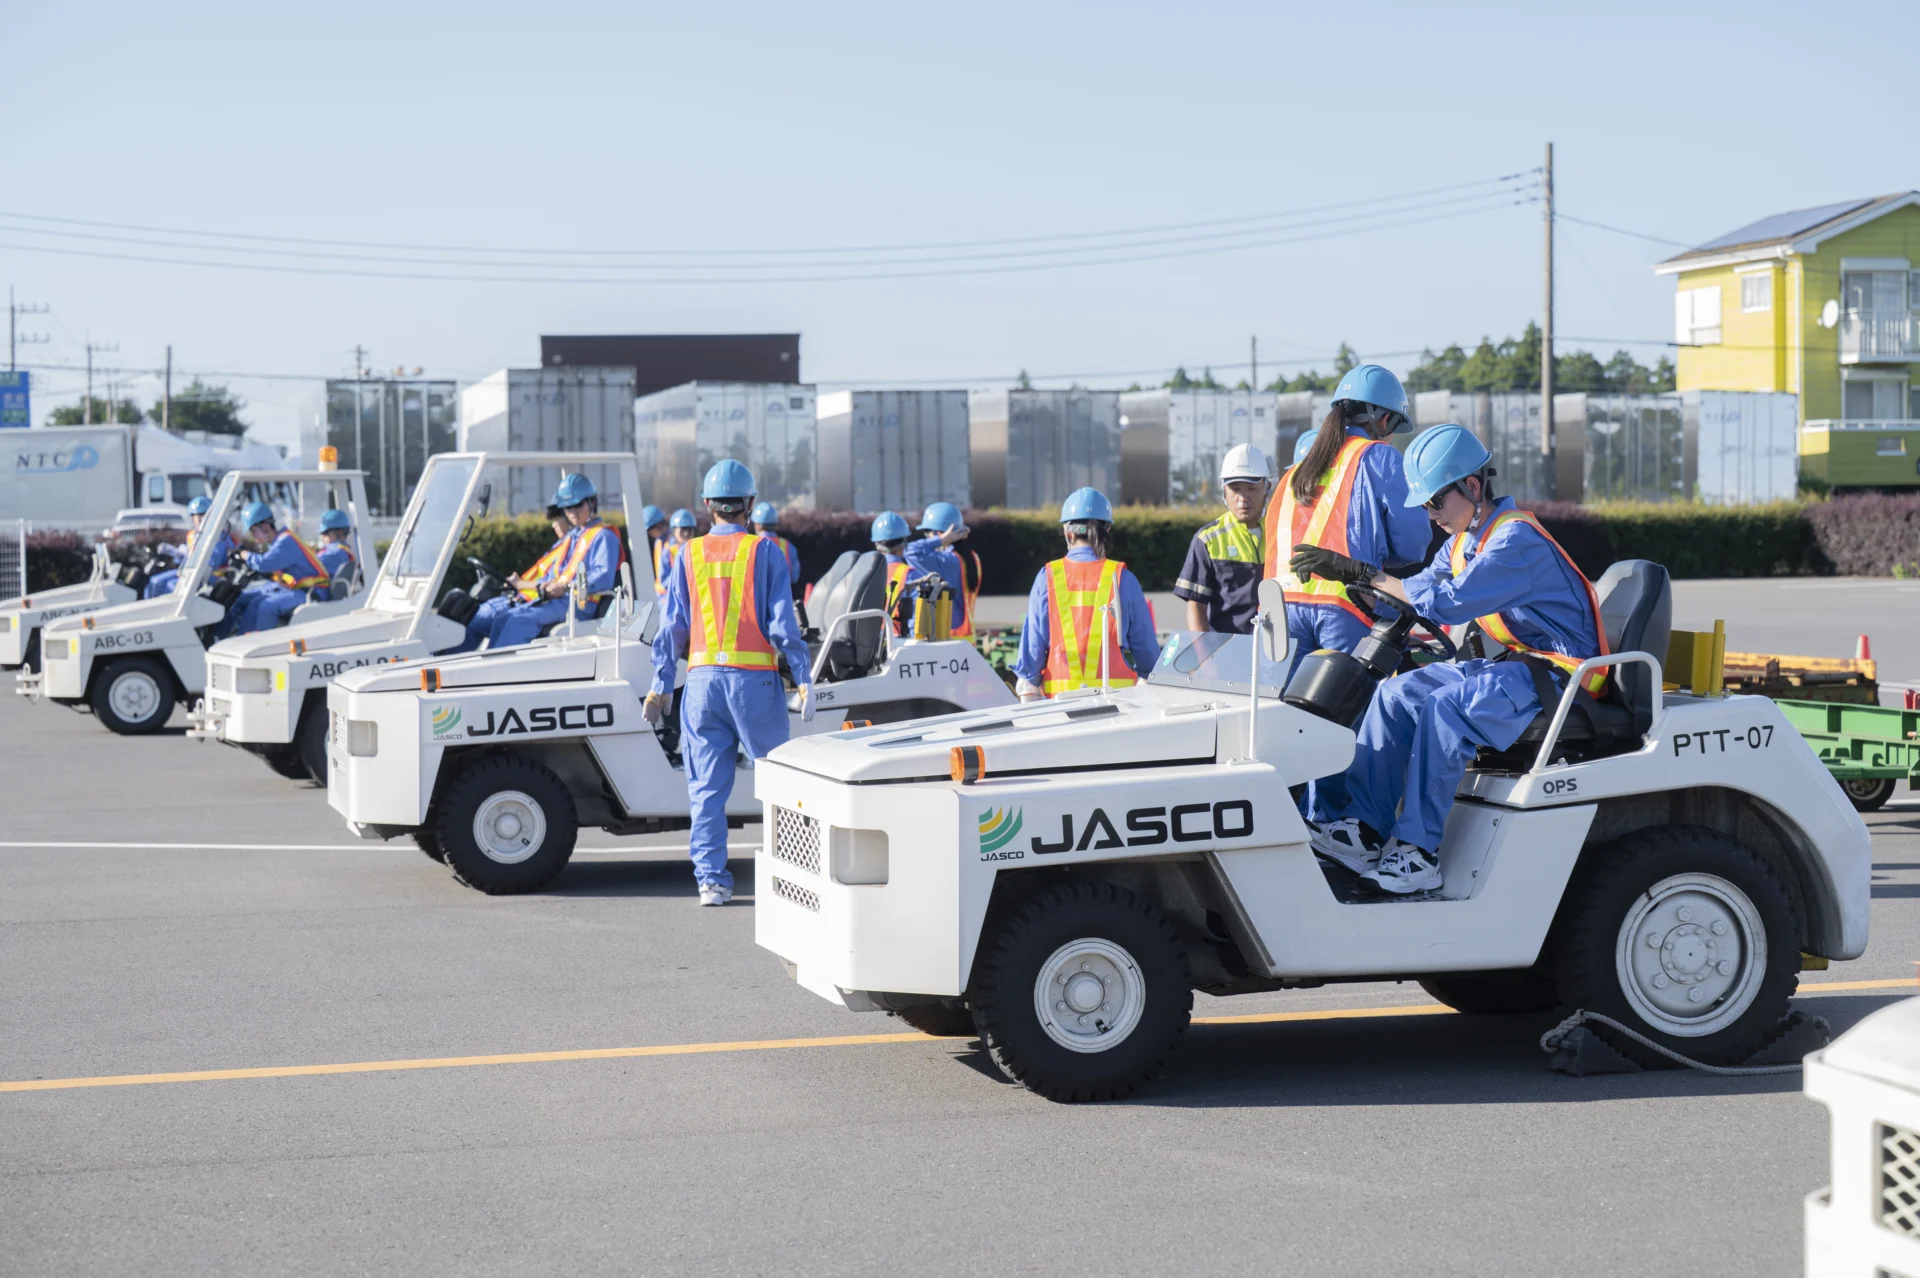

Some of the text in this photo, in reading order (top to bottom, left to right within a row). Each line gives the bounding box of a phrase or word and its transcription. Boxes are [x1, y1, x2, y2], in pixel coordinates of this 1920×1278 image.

[16, 452, 67, 468] NTC
[94, 631, 154, 649] ABC-03
[309, 655, 400, 680] ABC-N
[899, 658, 970, 679] RTT-04
[467, 703, 614, 737] JASCO
[1673, 725, 1774, 757] PTT-07
[1543, 777, 1578, 794] OPS
[1031, 799, 1254, 855] JASCO
[980, 851, 1025, 862] JASCO
